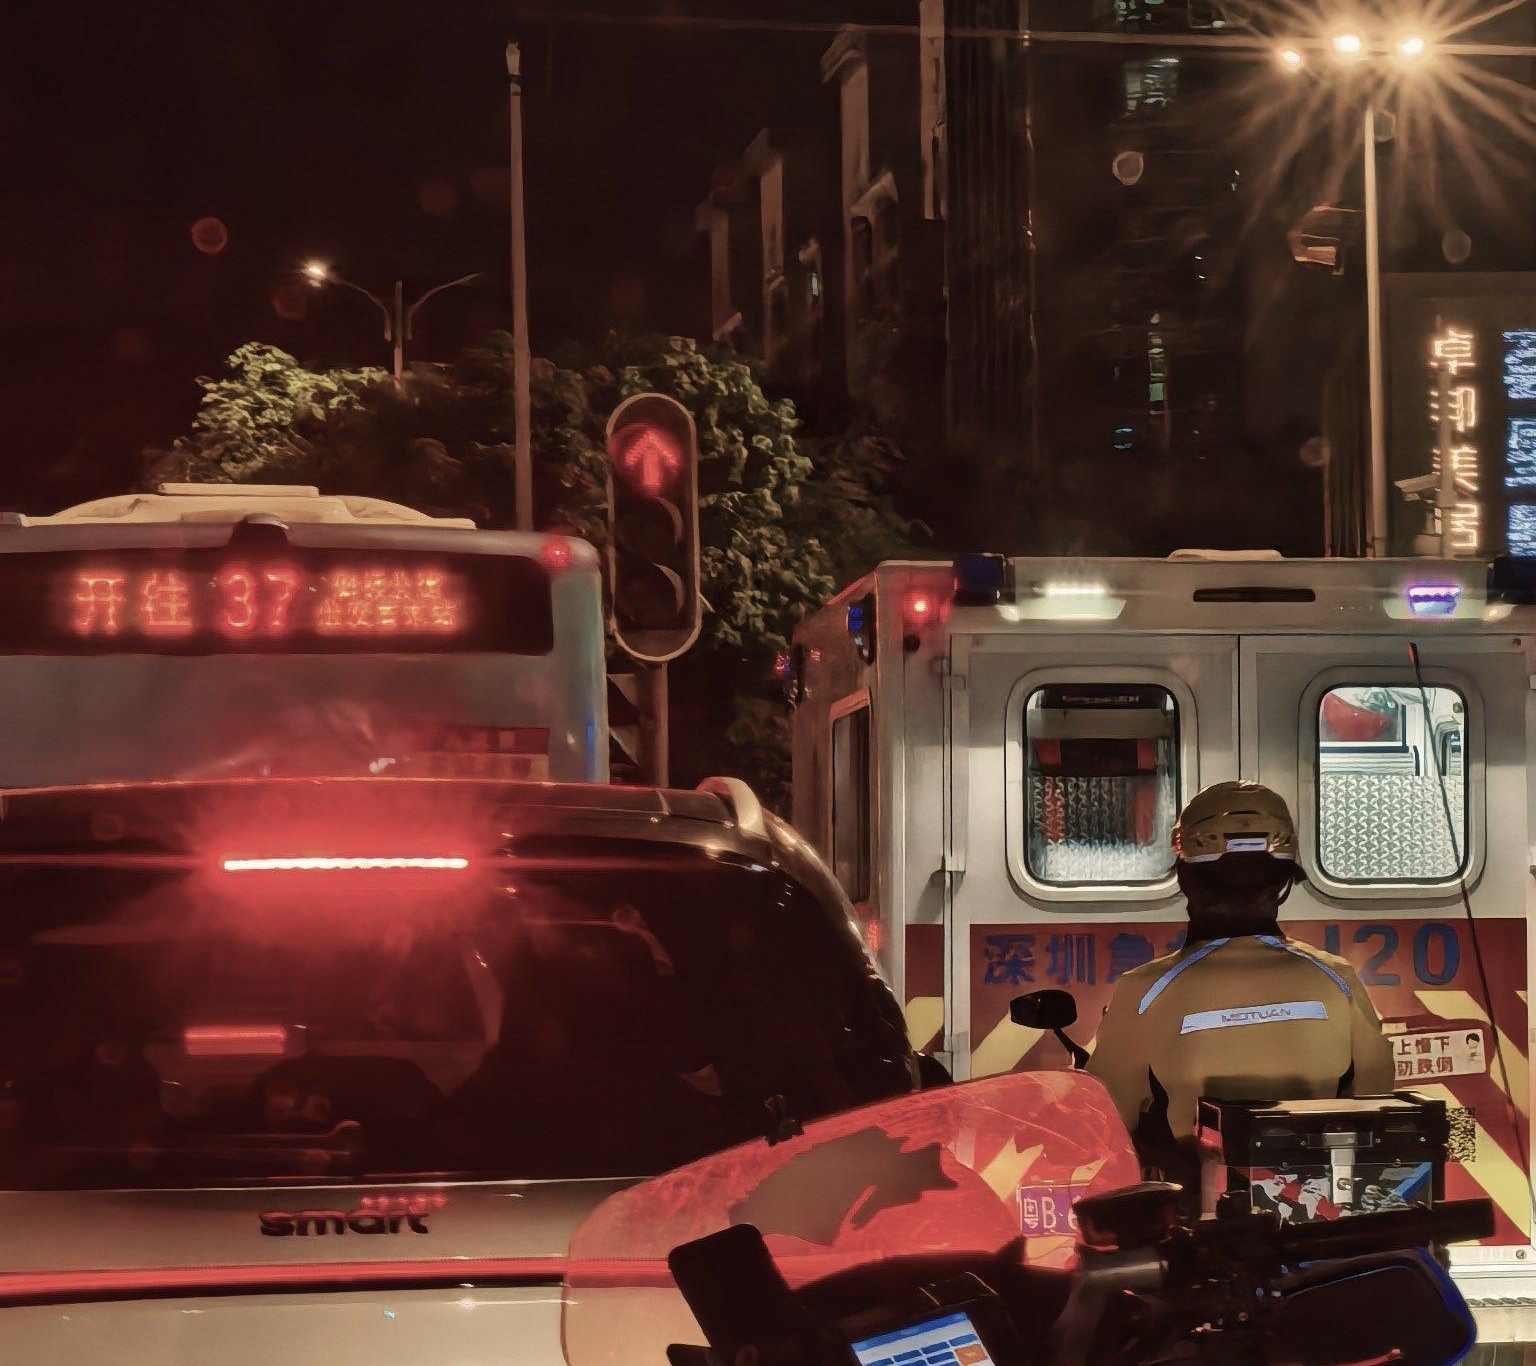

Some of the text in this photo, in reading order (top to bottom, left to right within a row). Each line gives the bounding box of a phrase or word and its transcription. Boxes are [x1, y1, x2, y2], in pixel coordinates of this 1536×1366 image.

[224, 571, 300, 629] 37
[984, 929, 1188, 985] 深圳急
[258, 1208, 430, 1236] smart
